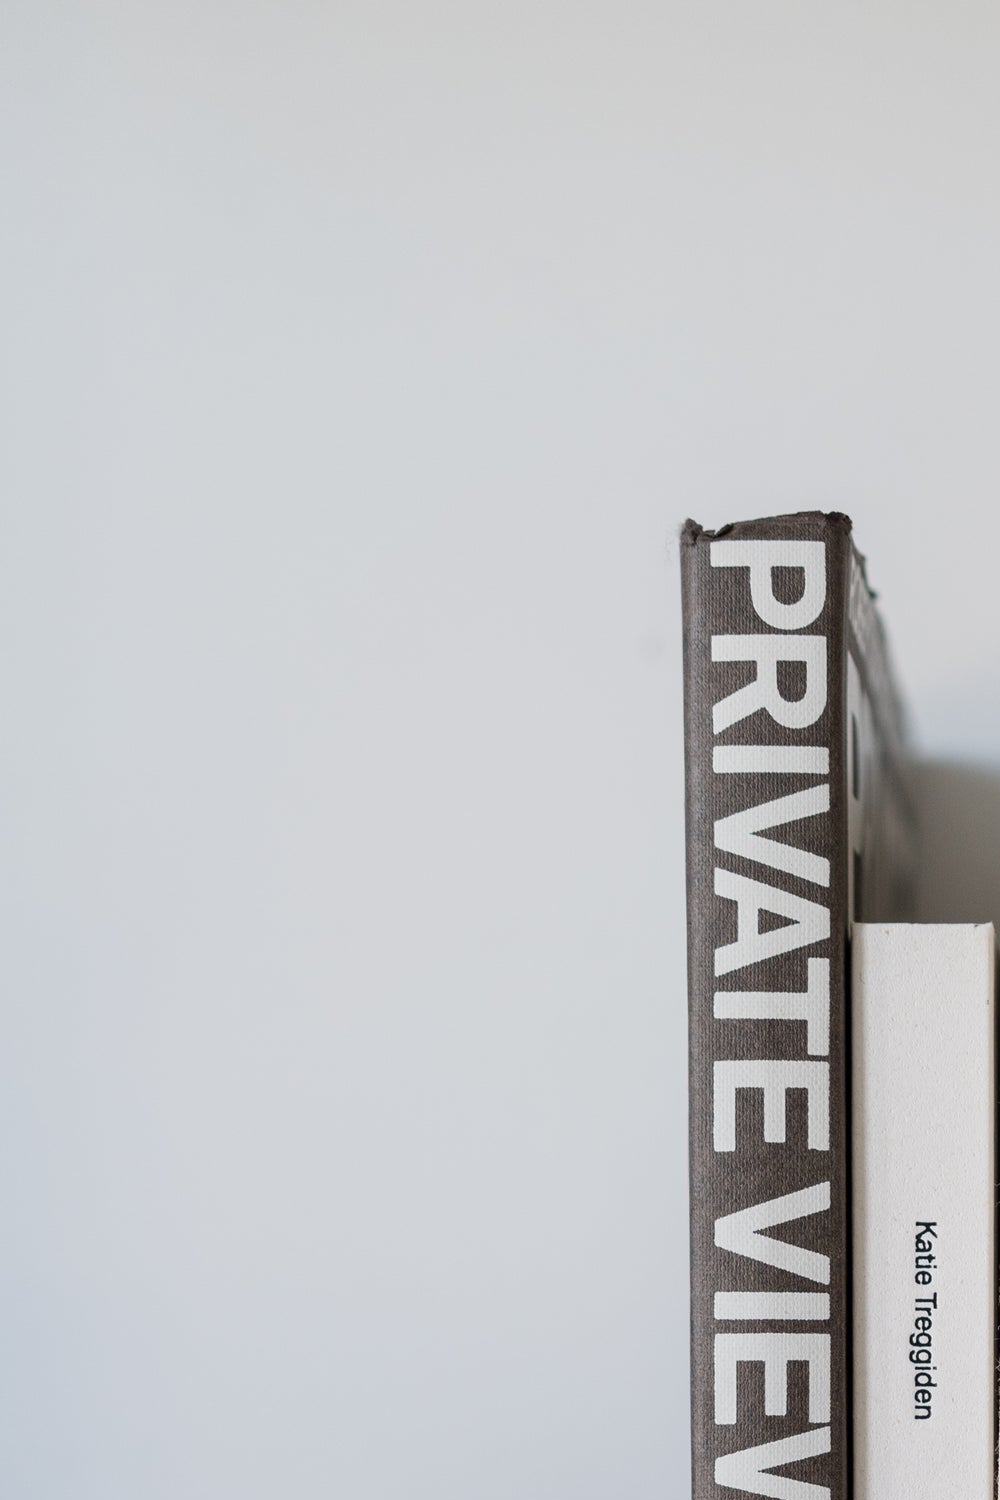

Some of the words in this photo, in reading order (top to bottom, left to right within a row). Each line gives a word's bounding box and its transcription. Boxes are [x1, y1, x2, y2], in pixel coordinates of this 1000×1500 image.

[710, 540, 830, 1151] PRIVATE
[914, 1221, 937, 1285] Katie
[909, 1292, 937, 1420] Treggiden
